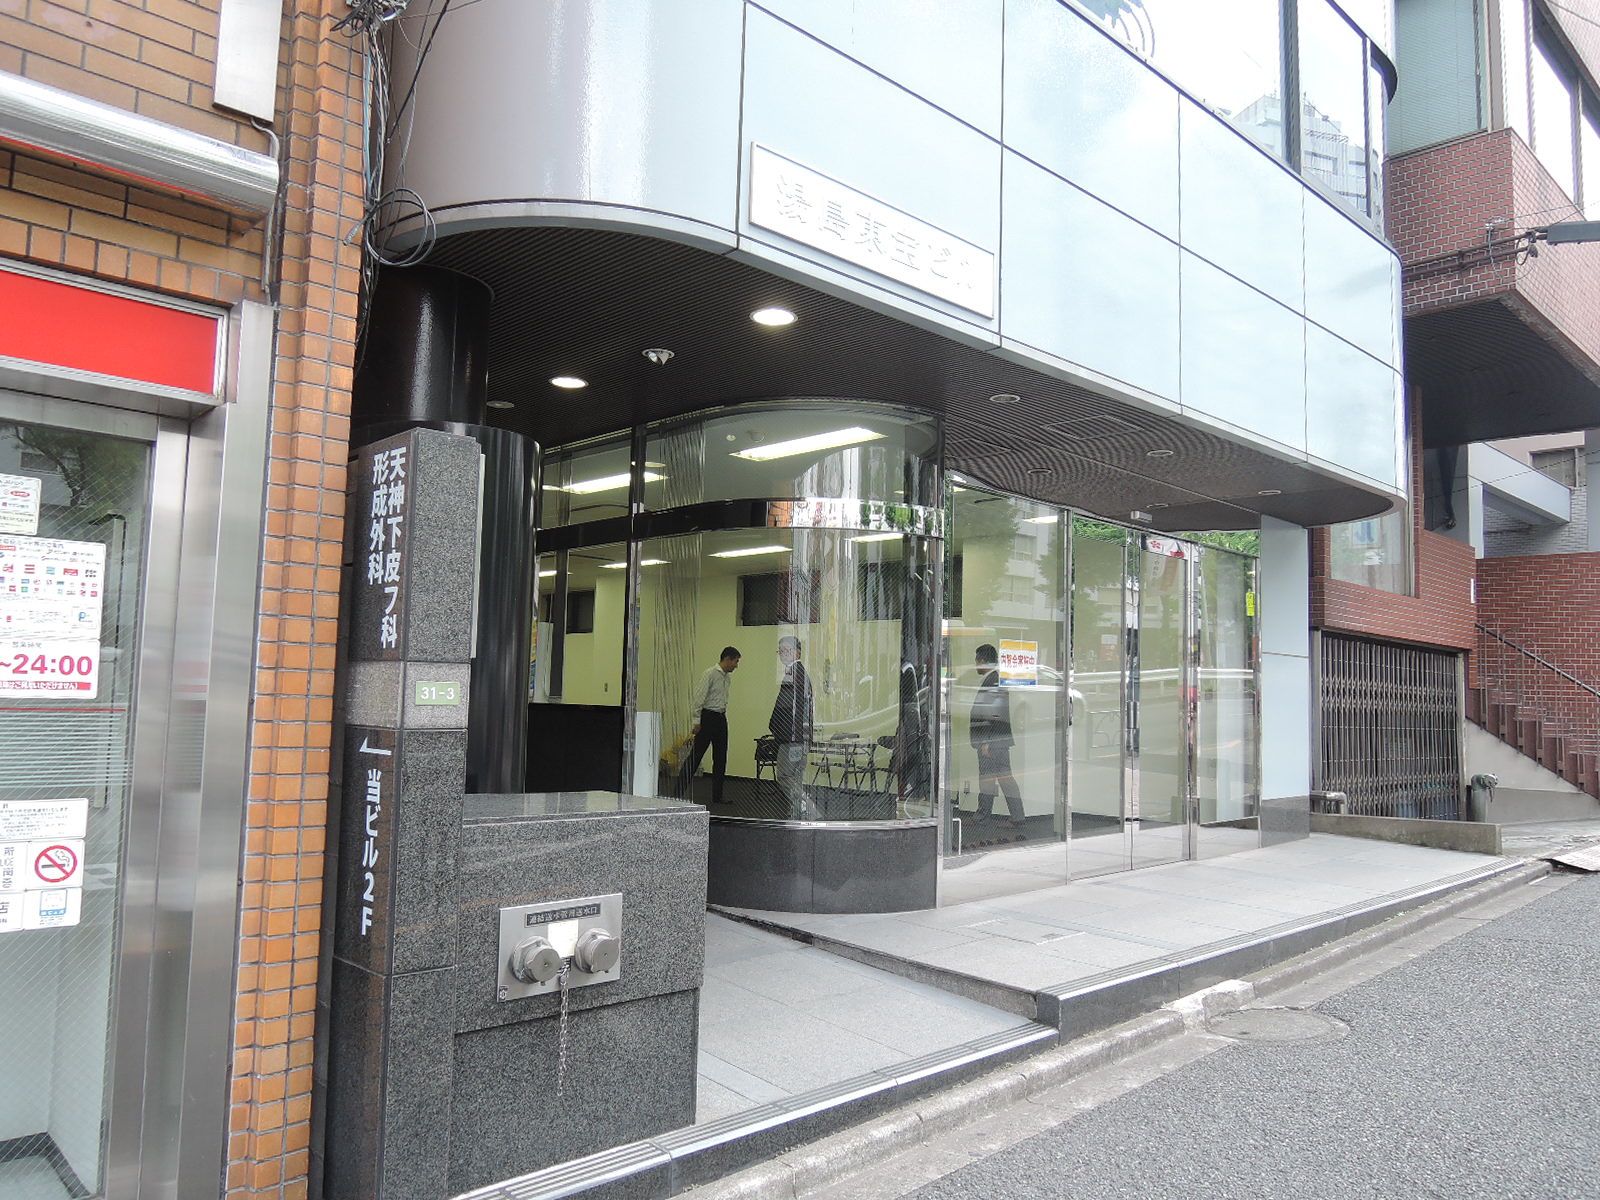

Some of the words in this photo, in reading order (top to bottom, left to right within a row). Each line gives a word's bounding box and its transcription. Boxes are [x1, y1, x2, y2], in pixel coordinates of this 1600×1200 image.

[368, 450, 390, 585] 形成外科
[380, 446, 407, 649] 天神下皮フ科
[420, 686, 455, 701] 31-3
[361, 768, 382, 936] 当ビル2F
